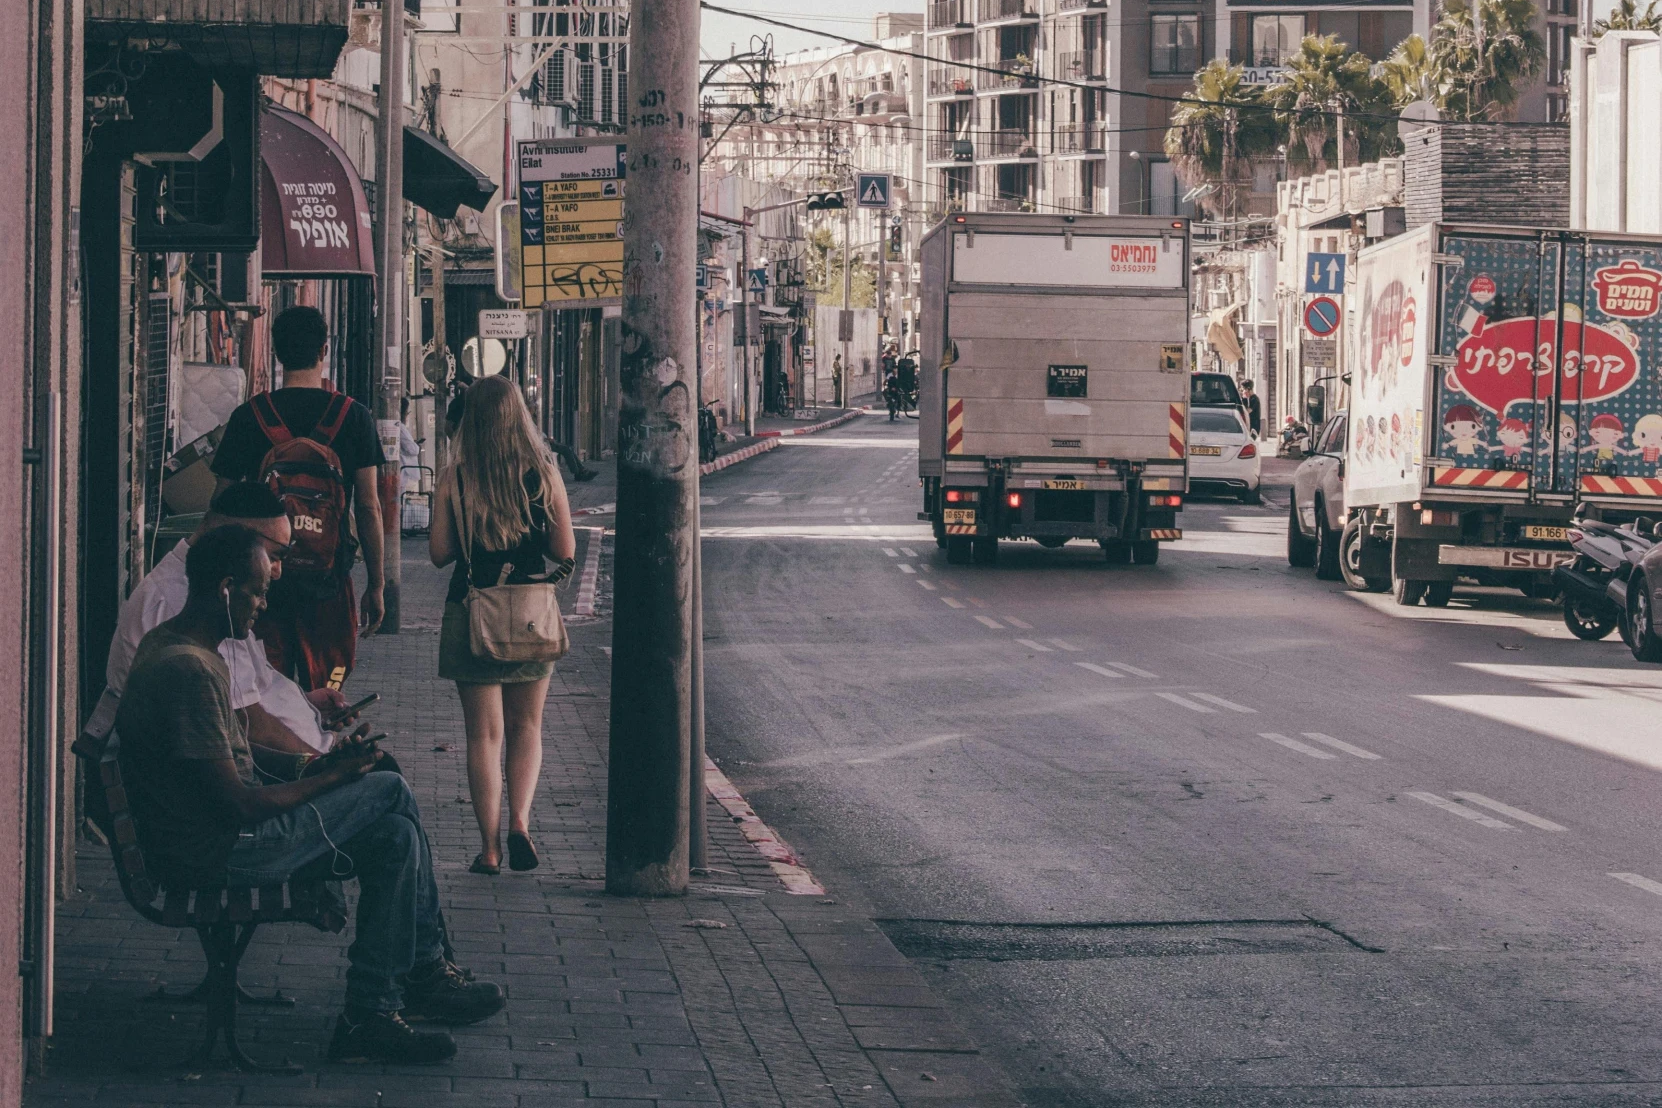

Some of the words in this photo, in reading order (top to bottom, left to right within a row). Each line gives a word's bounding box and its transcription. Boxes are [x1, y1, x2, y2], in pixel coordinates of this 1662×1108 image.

[522, 158, 542, 168] Eilat
[591, 168, 616, 177] 25331
[282, 183, 307, 196] זוגית
[308, 182, 336, 196] מיטה
[560, 182, 578, 192] YAFO
[296, 196, 320, 206] מזרון
[560, 203, 579, 212] YAFO
[290, 218, 350, 249] אופיר
[546, 225, 561, 234] BNEI
[562, 224, 581, 233] BRAK
[1111, 244, 1157, 263] נחמיאס
[1111, 264, 1157, 273] 03-5503979
[1608, 284, 1654, 300] חמים
[1605, 298, 1652, 312] וטעים
[1464, 342, 1553, 376] צרפתי
[1060, 368, 1086, 377] אמיר
[1052, 481, 1077, 490] אמיר
[294, 515, 323, 533] USC
